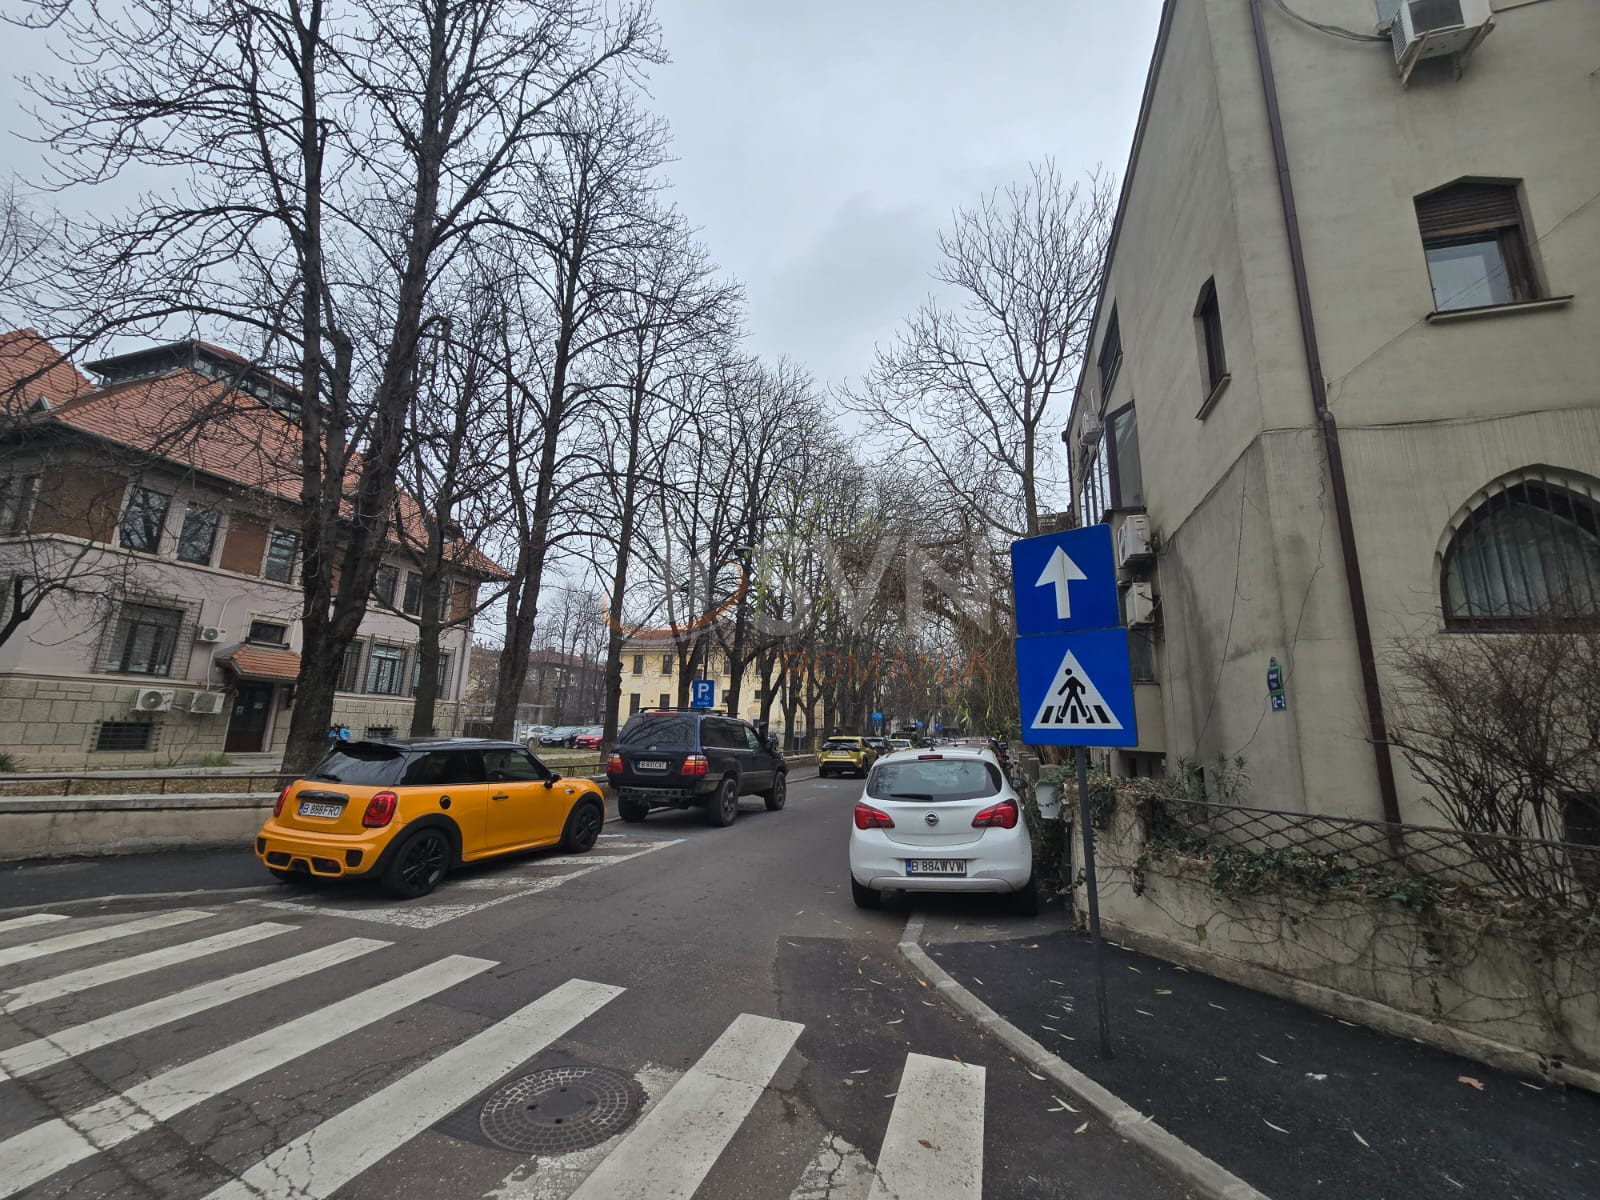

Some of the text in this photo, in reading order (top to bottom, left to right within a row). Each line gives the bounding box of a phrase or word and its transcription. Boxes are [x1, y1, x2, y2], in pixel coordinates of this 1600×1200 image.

[698, 683, 709, 698] P
[303, 804, 339, 816] B 888FRO
[912, 861, 964, 872] B 884WVW
